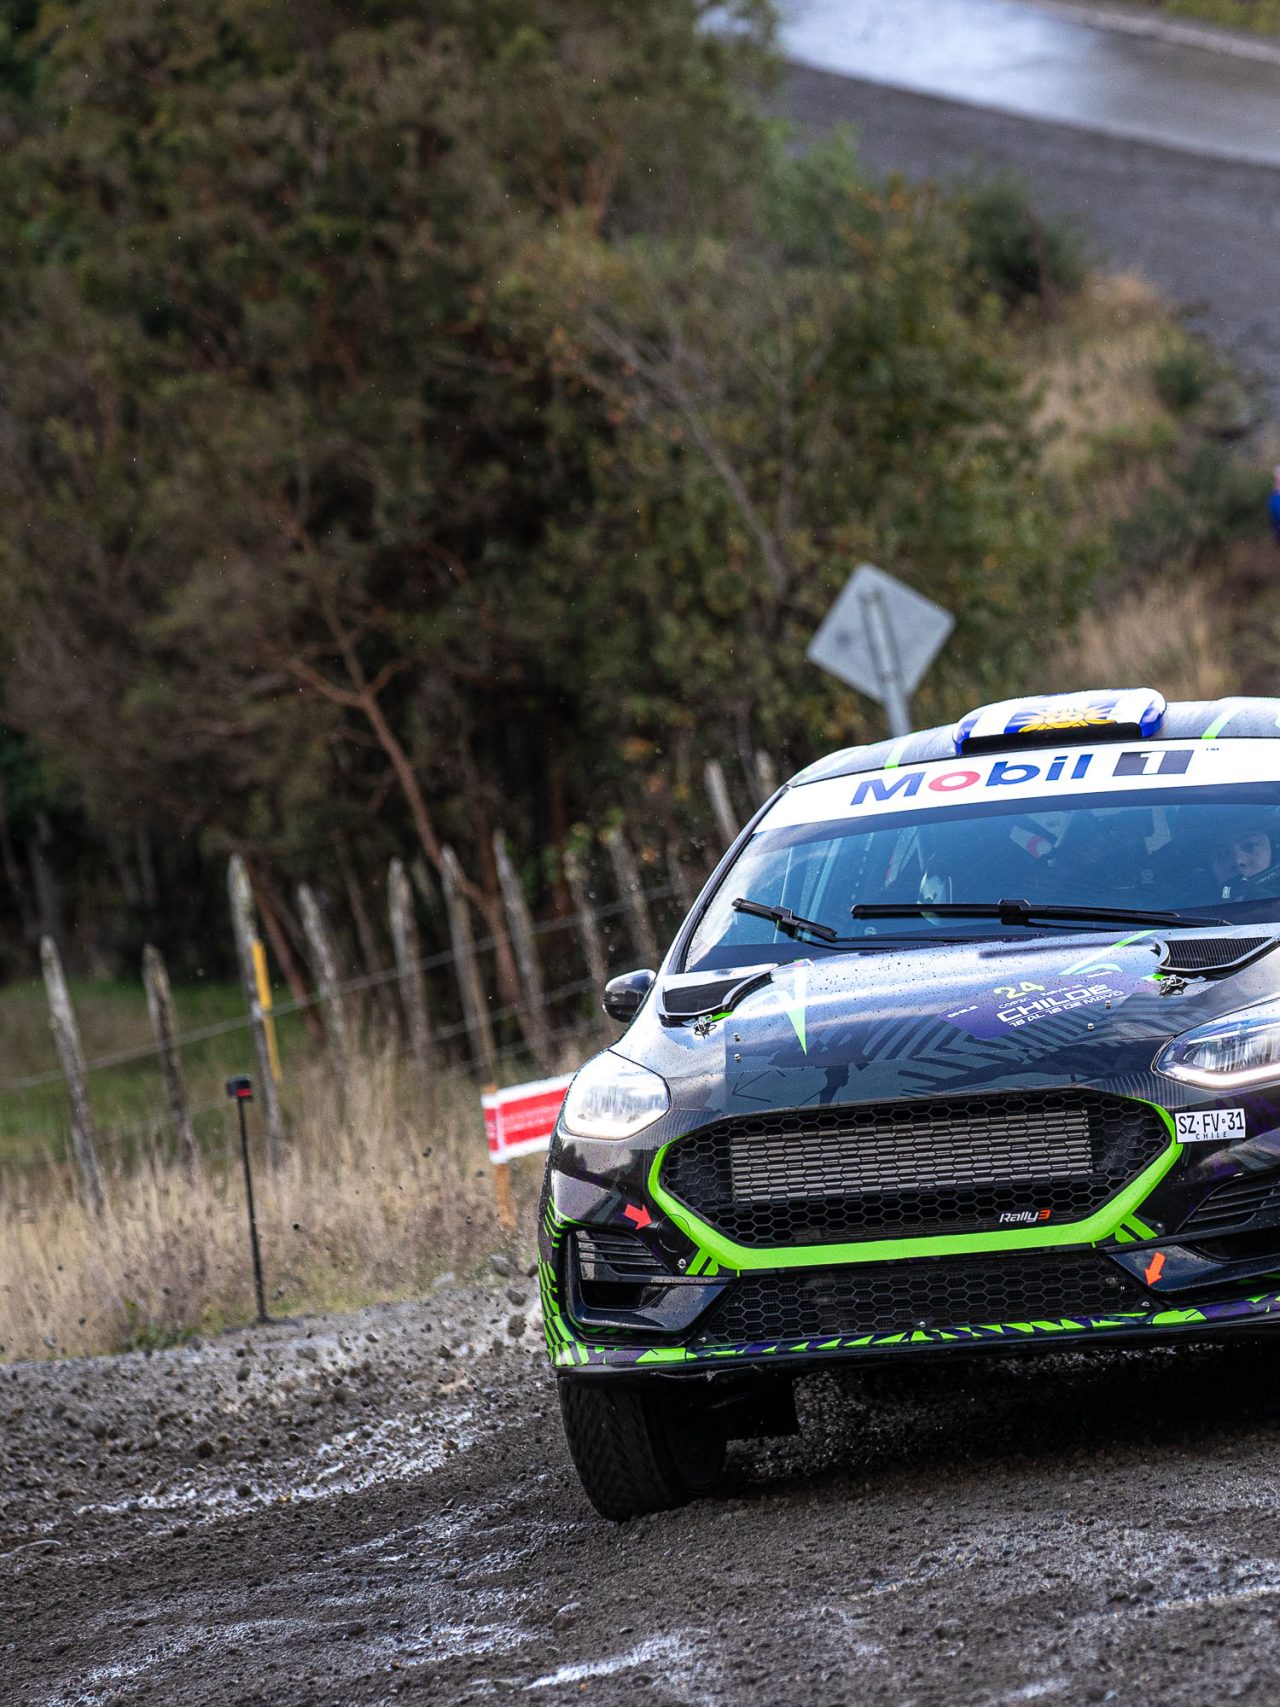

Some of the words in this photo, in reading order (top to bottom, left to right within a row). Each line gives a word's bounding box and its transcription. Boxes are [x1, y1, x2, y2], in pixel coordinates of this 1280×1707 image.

[850, 753, 1094, 806] Mobil
[993, 981, 1047, 1001] 24
[996, 984, 1113, 1023] CHILOÉ
[1026, 1013, 1046, 1023] AL
[1063, 1000, 1083, 1010] DE
[1083, 990, 1124, 1005] MAYO
[1195, 1131, 1227, 1140] CHILE
[999, 1209, 1051, 1223] Rally3
